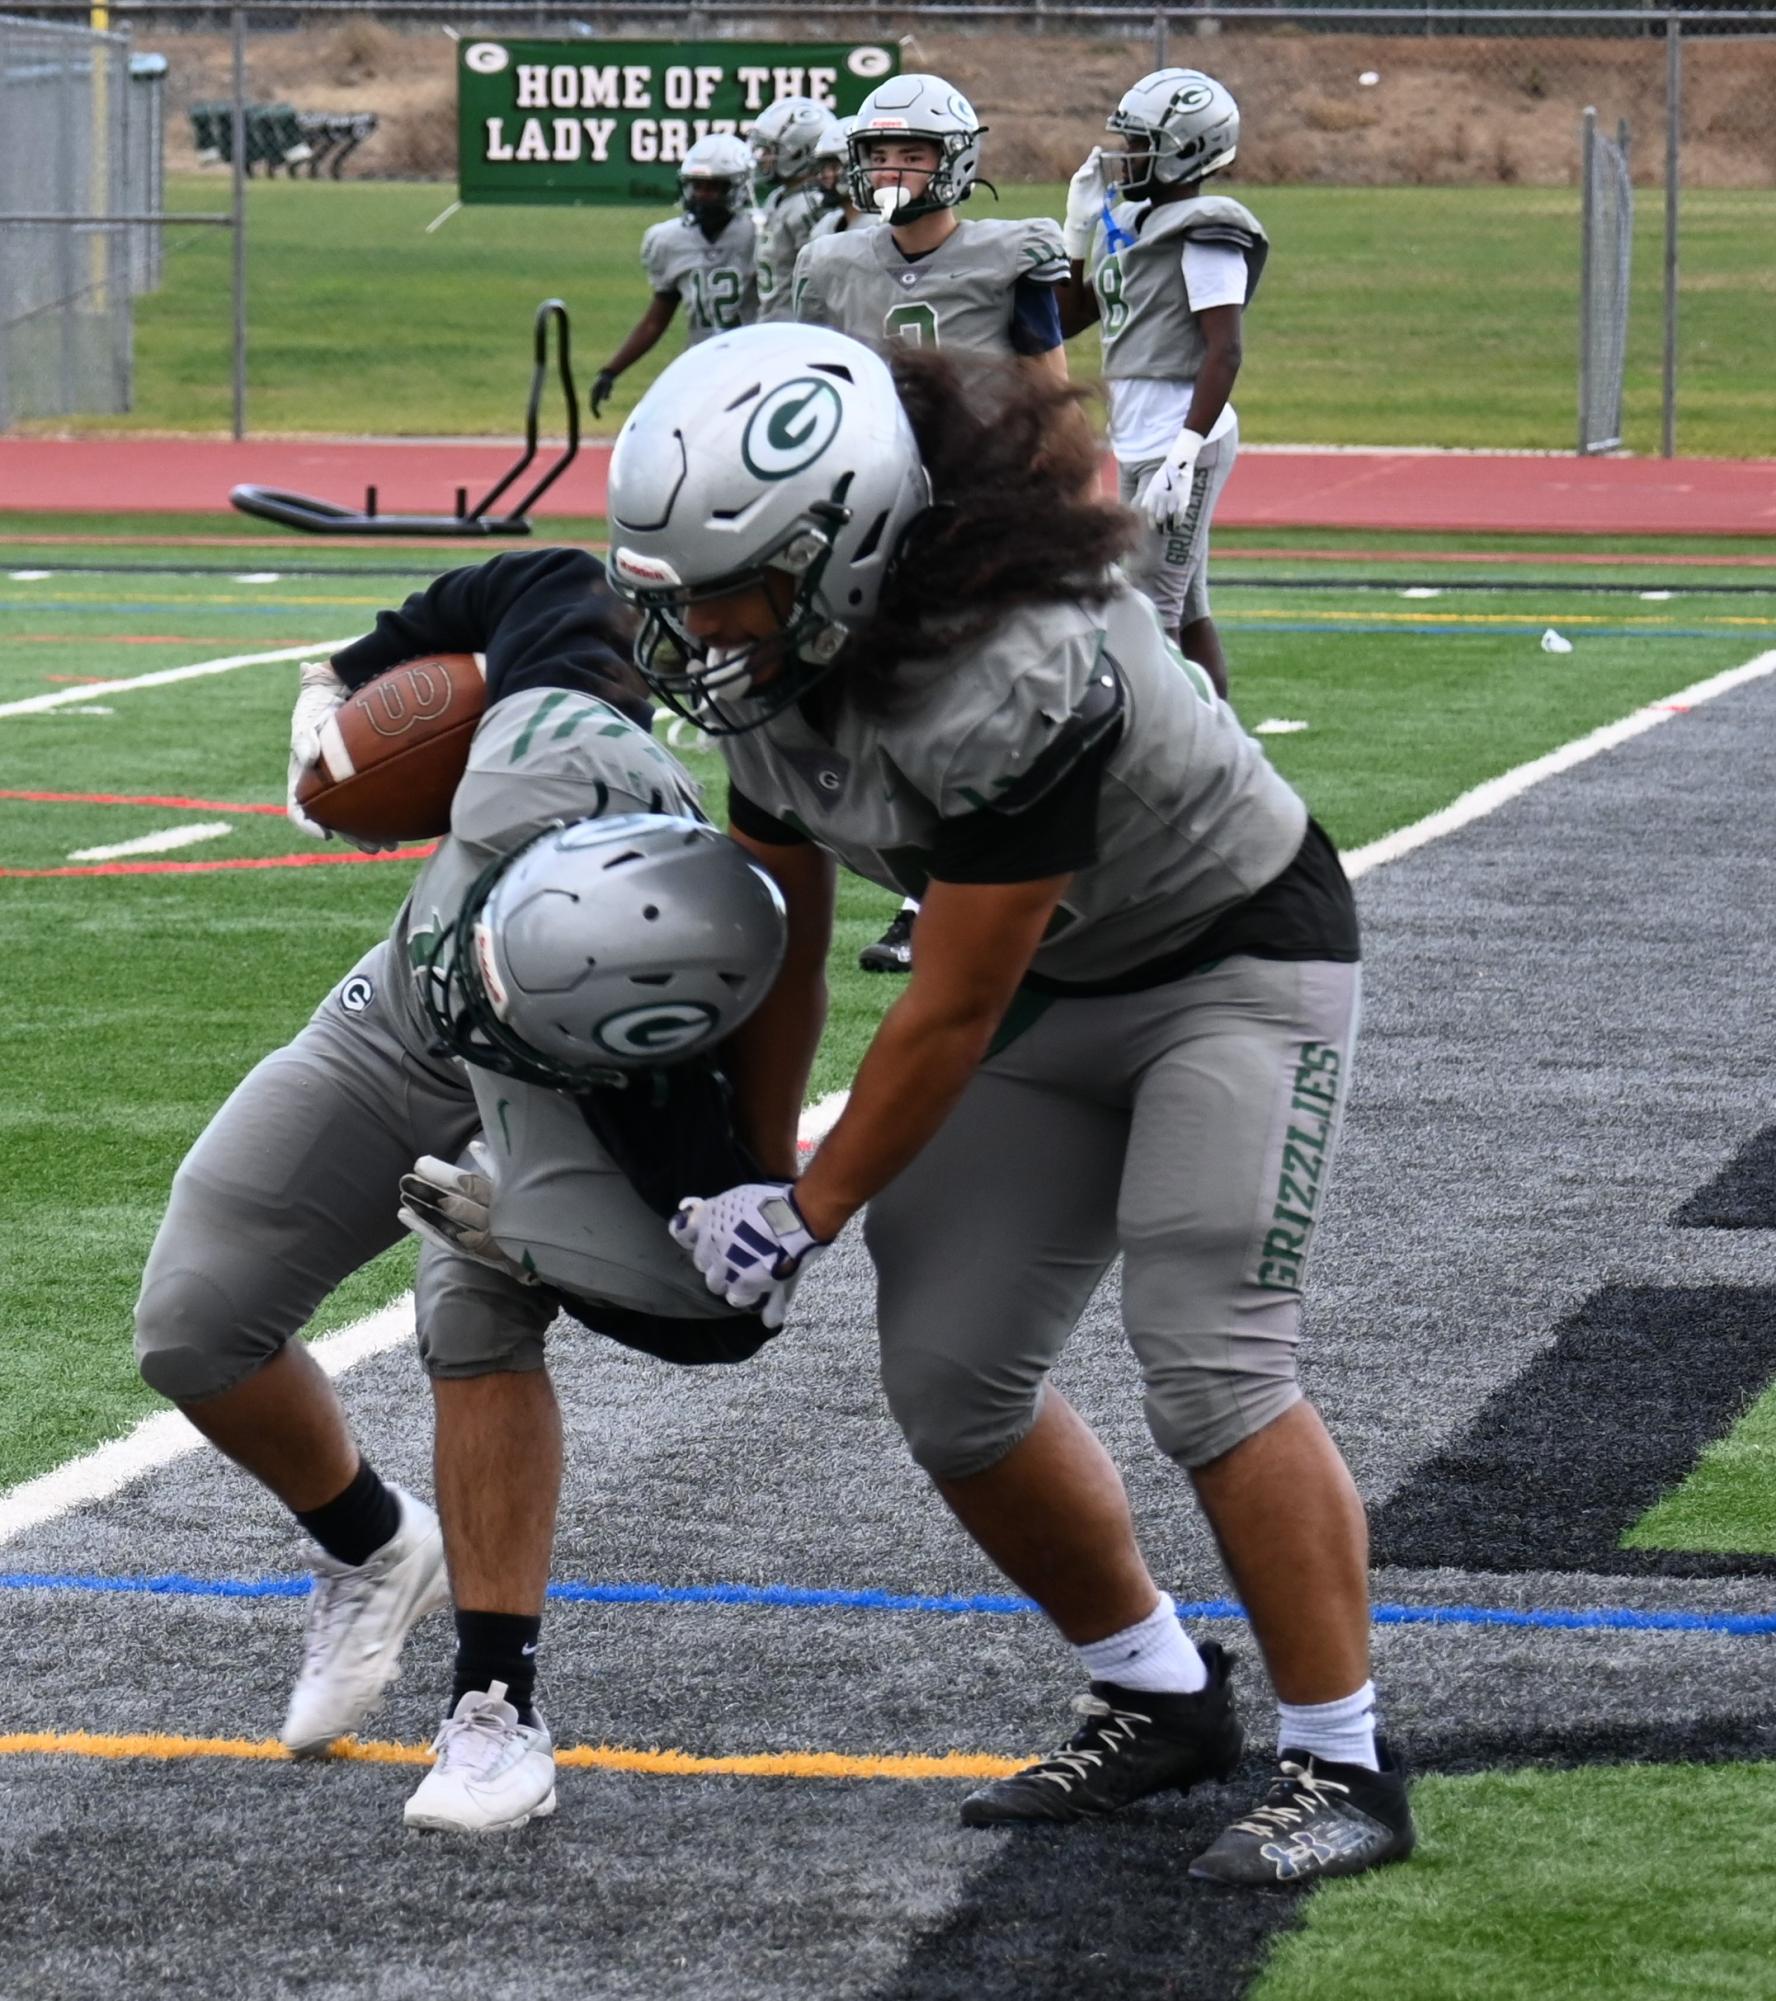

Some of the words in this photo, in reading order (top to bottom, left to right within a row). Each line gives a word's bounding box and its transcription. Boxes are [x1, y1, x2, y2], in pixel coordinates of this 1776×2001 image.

[516, 65, 652, 109] HOME
[664, 66, 723, 109] OF
[737, 67, 837, 110] THE
[486, 117, 618, 161] LADY
[744, 378, 842, 479] G
[341, 976, 373, 1012] G
[595, 1001, 718, 1060] G
[1257, 1041, 1340, 1293] GRIZZLIES
